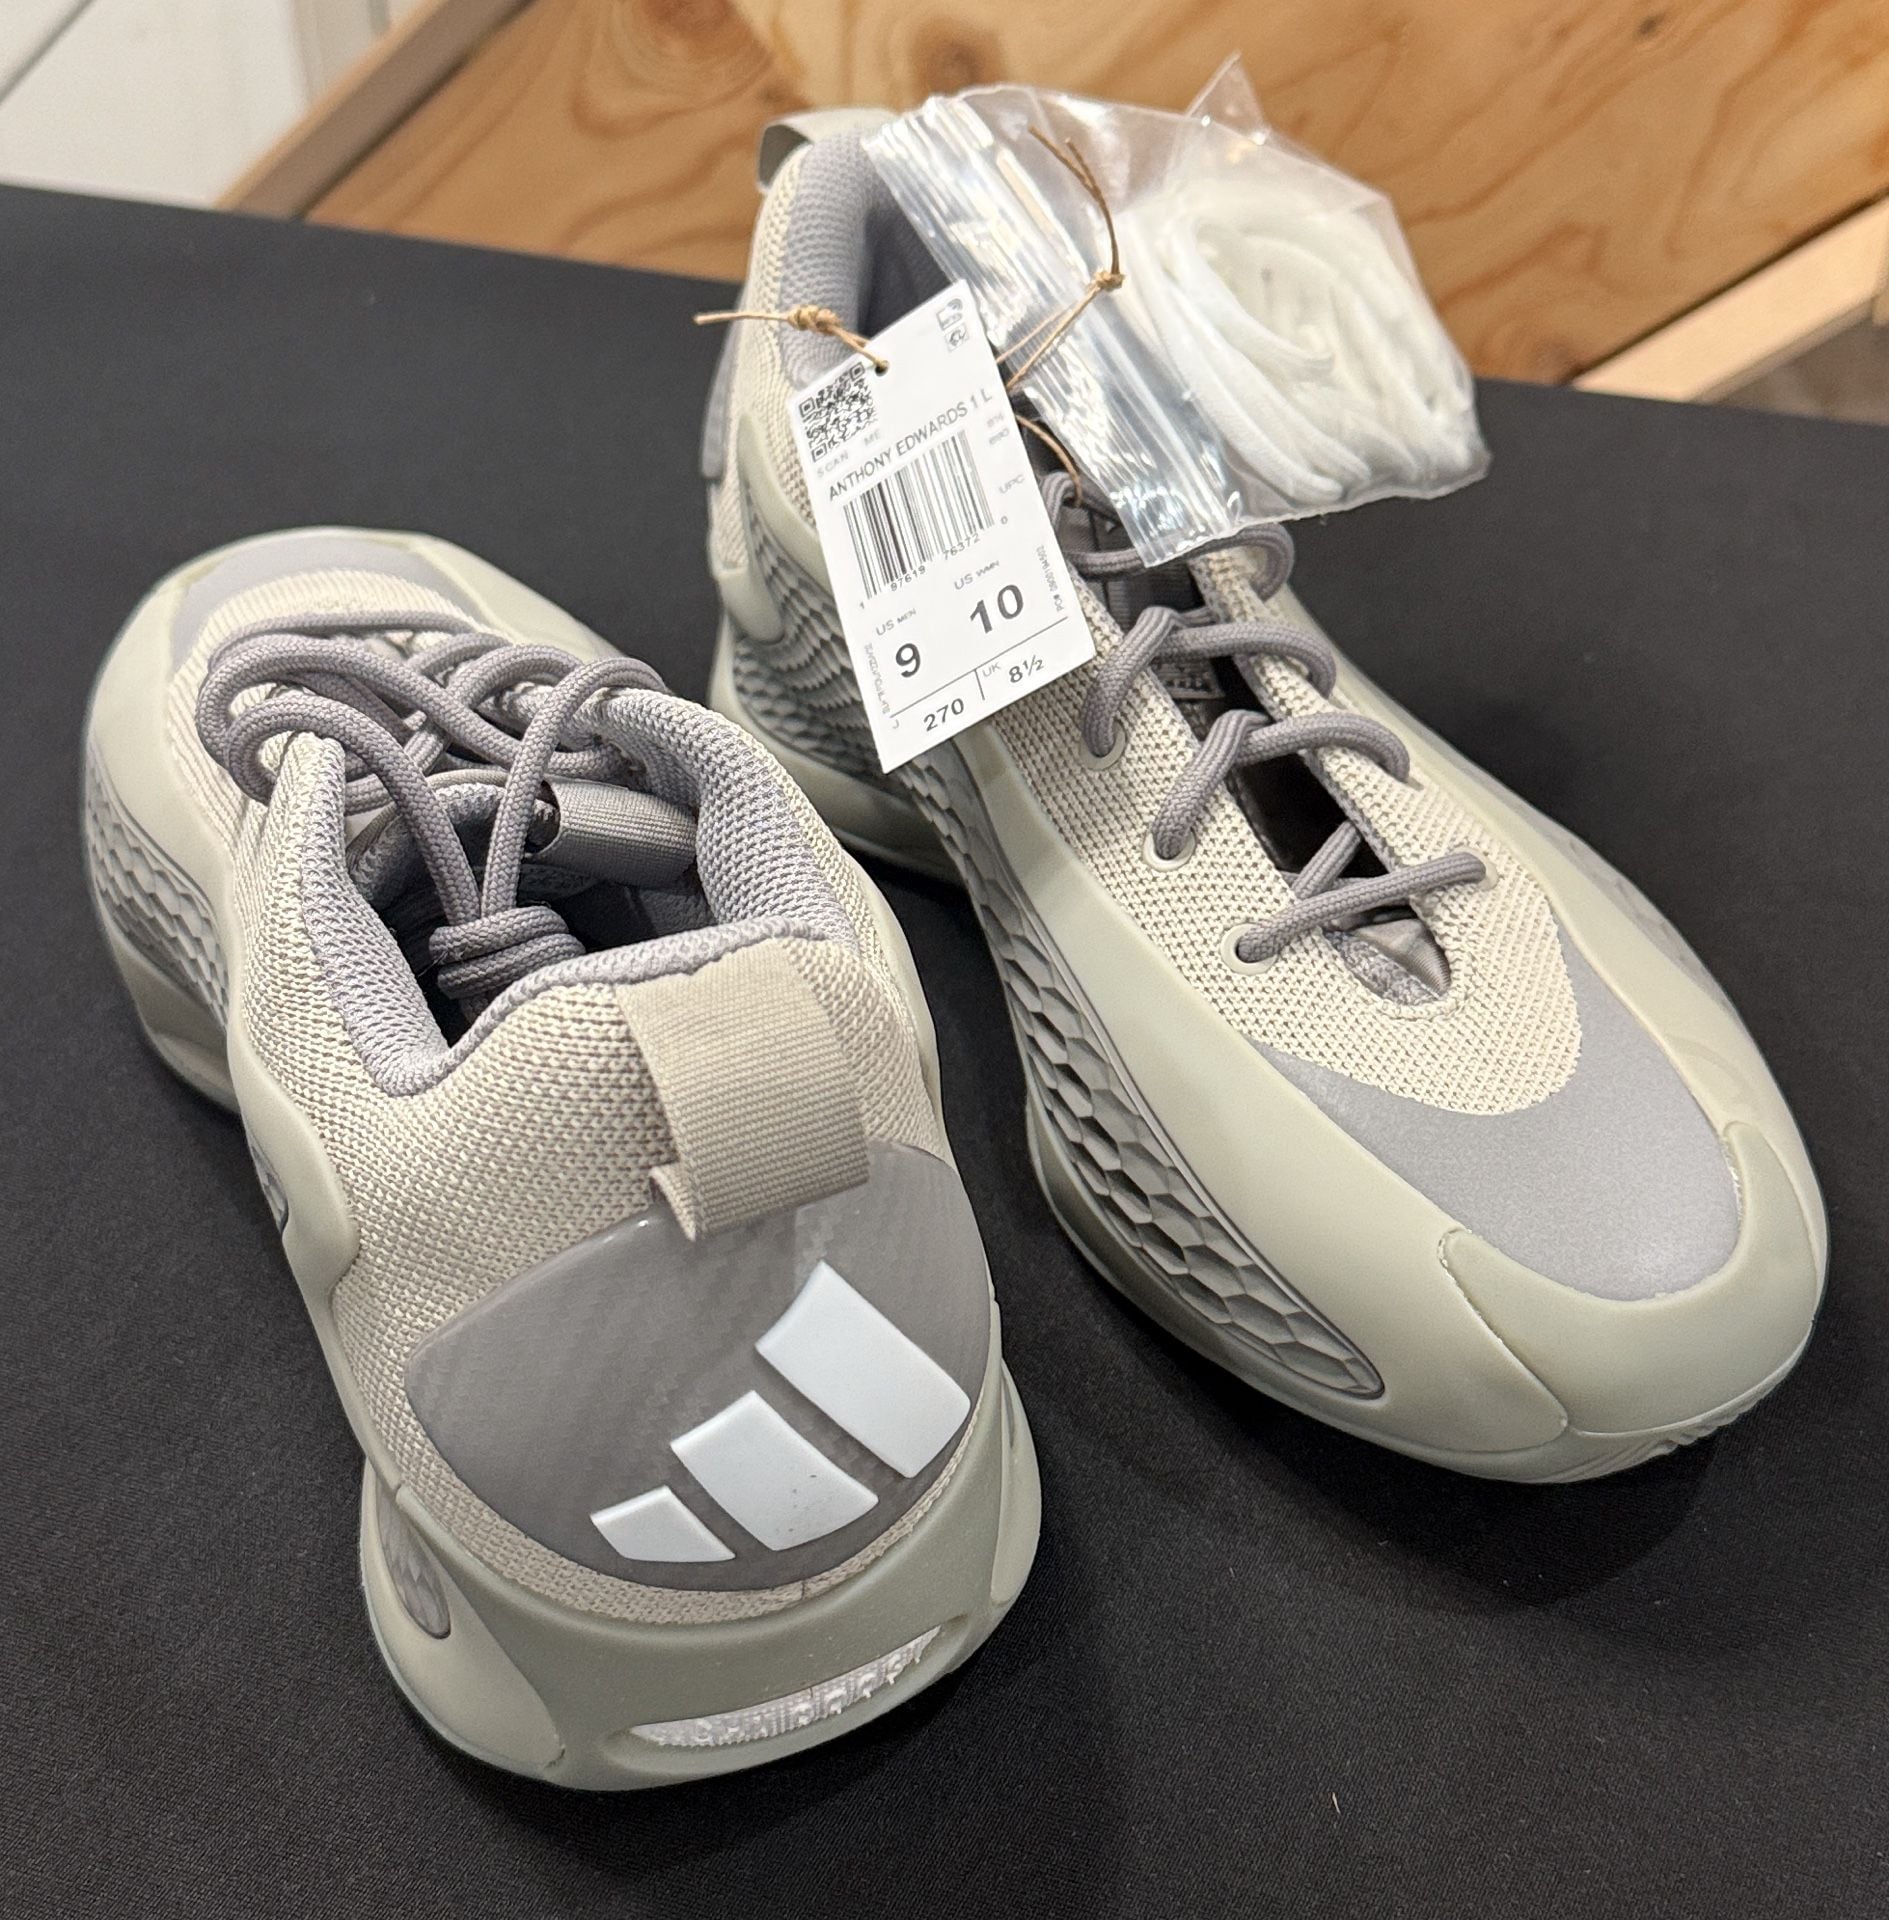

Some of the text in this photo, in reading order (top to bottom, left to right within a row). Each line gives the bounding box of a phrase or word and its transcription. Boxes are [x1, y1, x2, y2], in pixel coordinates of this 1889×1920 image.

[829, 448, 893, 501] ANTHONY
[895, 401, 968, 456] EDWARDS
[970, 396, 979, 409] 1
[981, 388, 993, 402] L
[816, 450, 850, 477] SCAN
[998, 474, 1025, 494] UPC
[942, 533, 981, 560] 76372
[954, 560, 1000, 590] US WMN
[875, 608, 917, 637] US MEN
[970, 584, 1024, 635] 10
[895, 643, 922, 678] 9
[982, 661, 1002, 678] UK
[1008, 654, 1045, 684] 8½
[923, 698, 965, 732] 270
